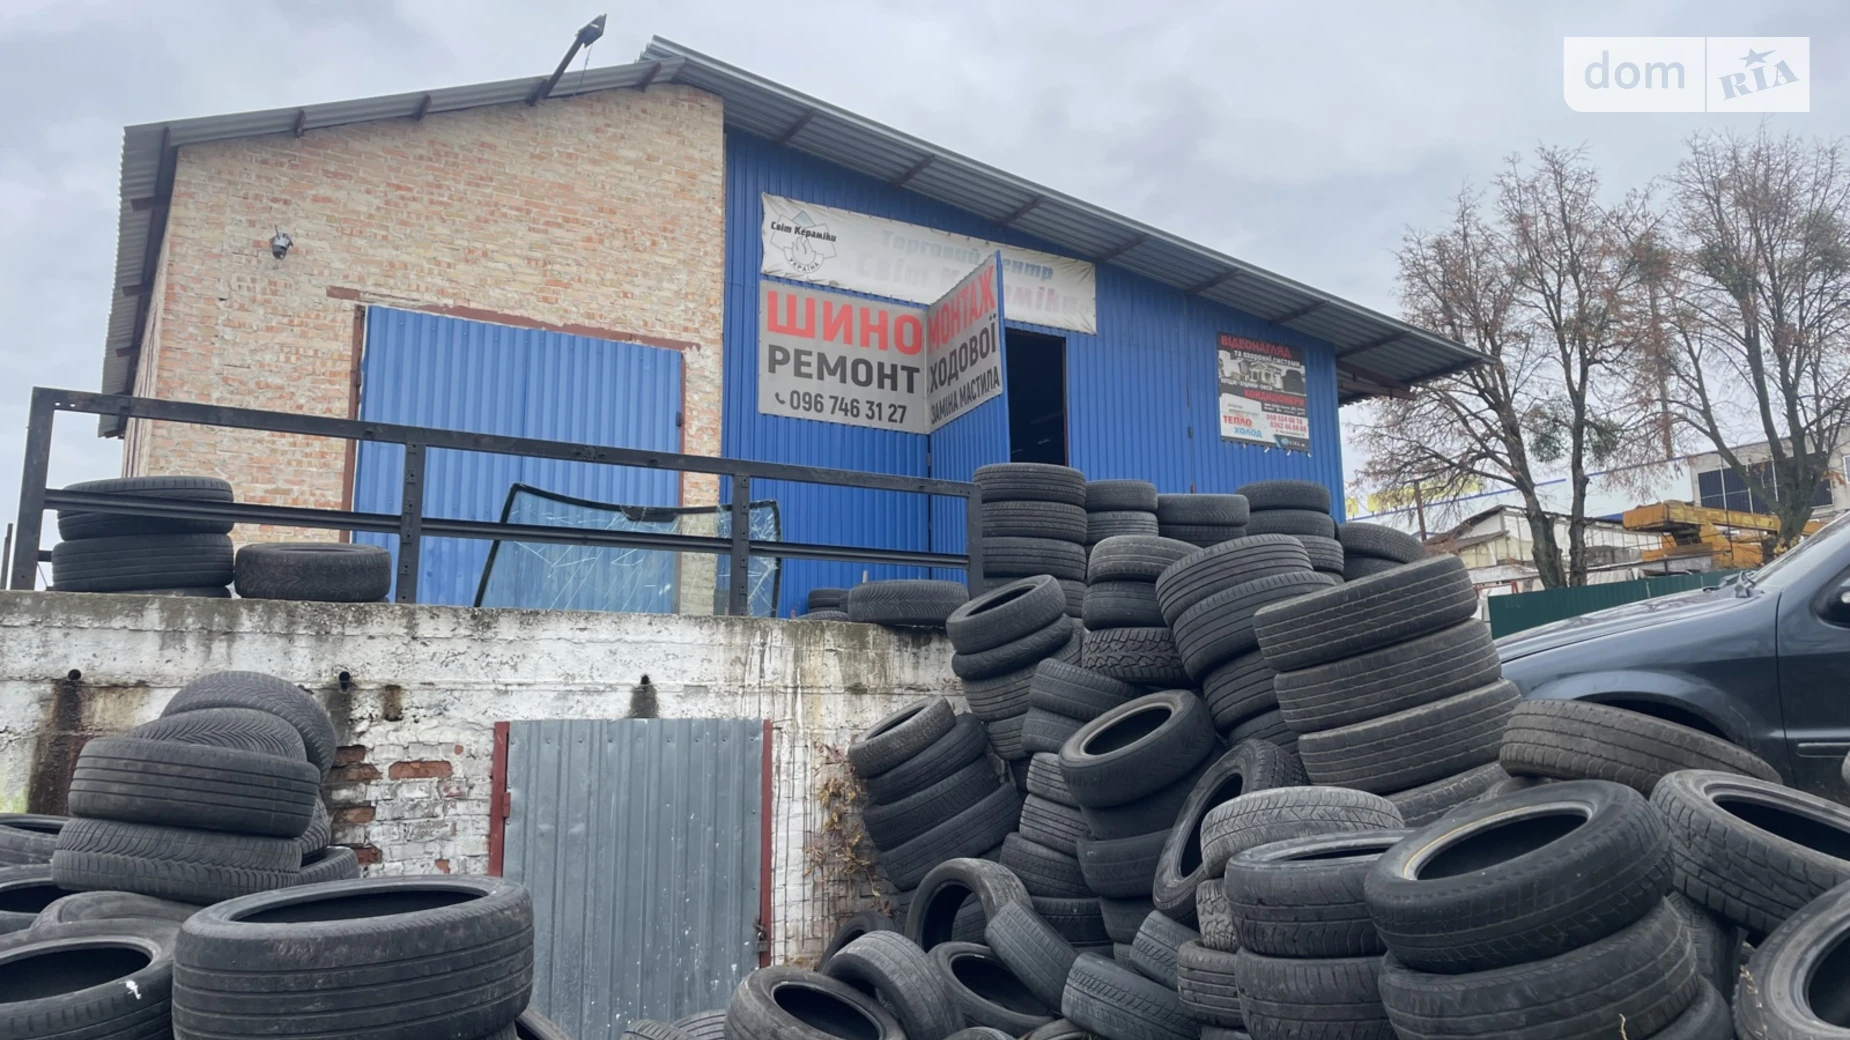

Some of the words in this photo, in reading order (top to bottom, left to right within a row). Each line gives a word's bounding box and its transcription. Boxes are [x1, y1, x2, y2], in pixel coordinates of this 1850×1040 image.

[1003, 258, 1054, 282] ентр
[767, 290, 923, 355] ШИНО
[928, 265, 996, 353] МОНТАЖ
[930, 313, 997, 394] ХОДОВОЇ
[1221, 335, 1291, 358] ВІДЕОНАГЛЯД
[768, 344, 920, 394] РЕМОНТ
[789, 390, 824, 414] 096
[829, 395, 860, 418] 746
[865, 400, 882, 421] 31
[888, 404, 907, 424] 27
[931, 392, 959, 425] ЗАМІНА
[960, 366, 1000, 407] МАСТИЛА
[1223, 415, 1252, 427] ТЕПЛО
[1234, 427, 1262, 438] ХОЛОД
